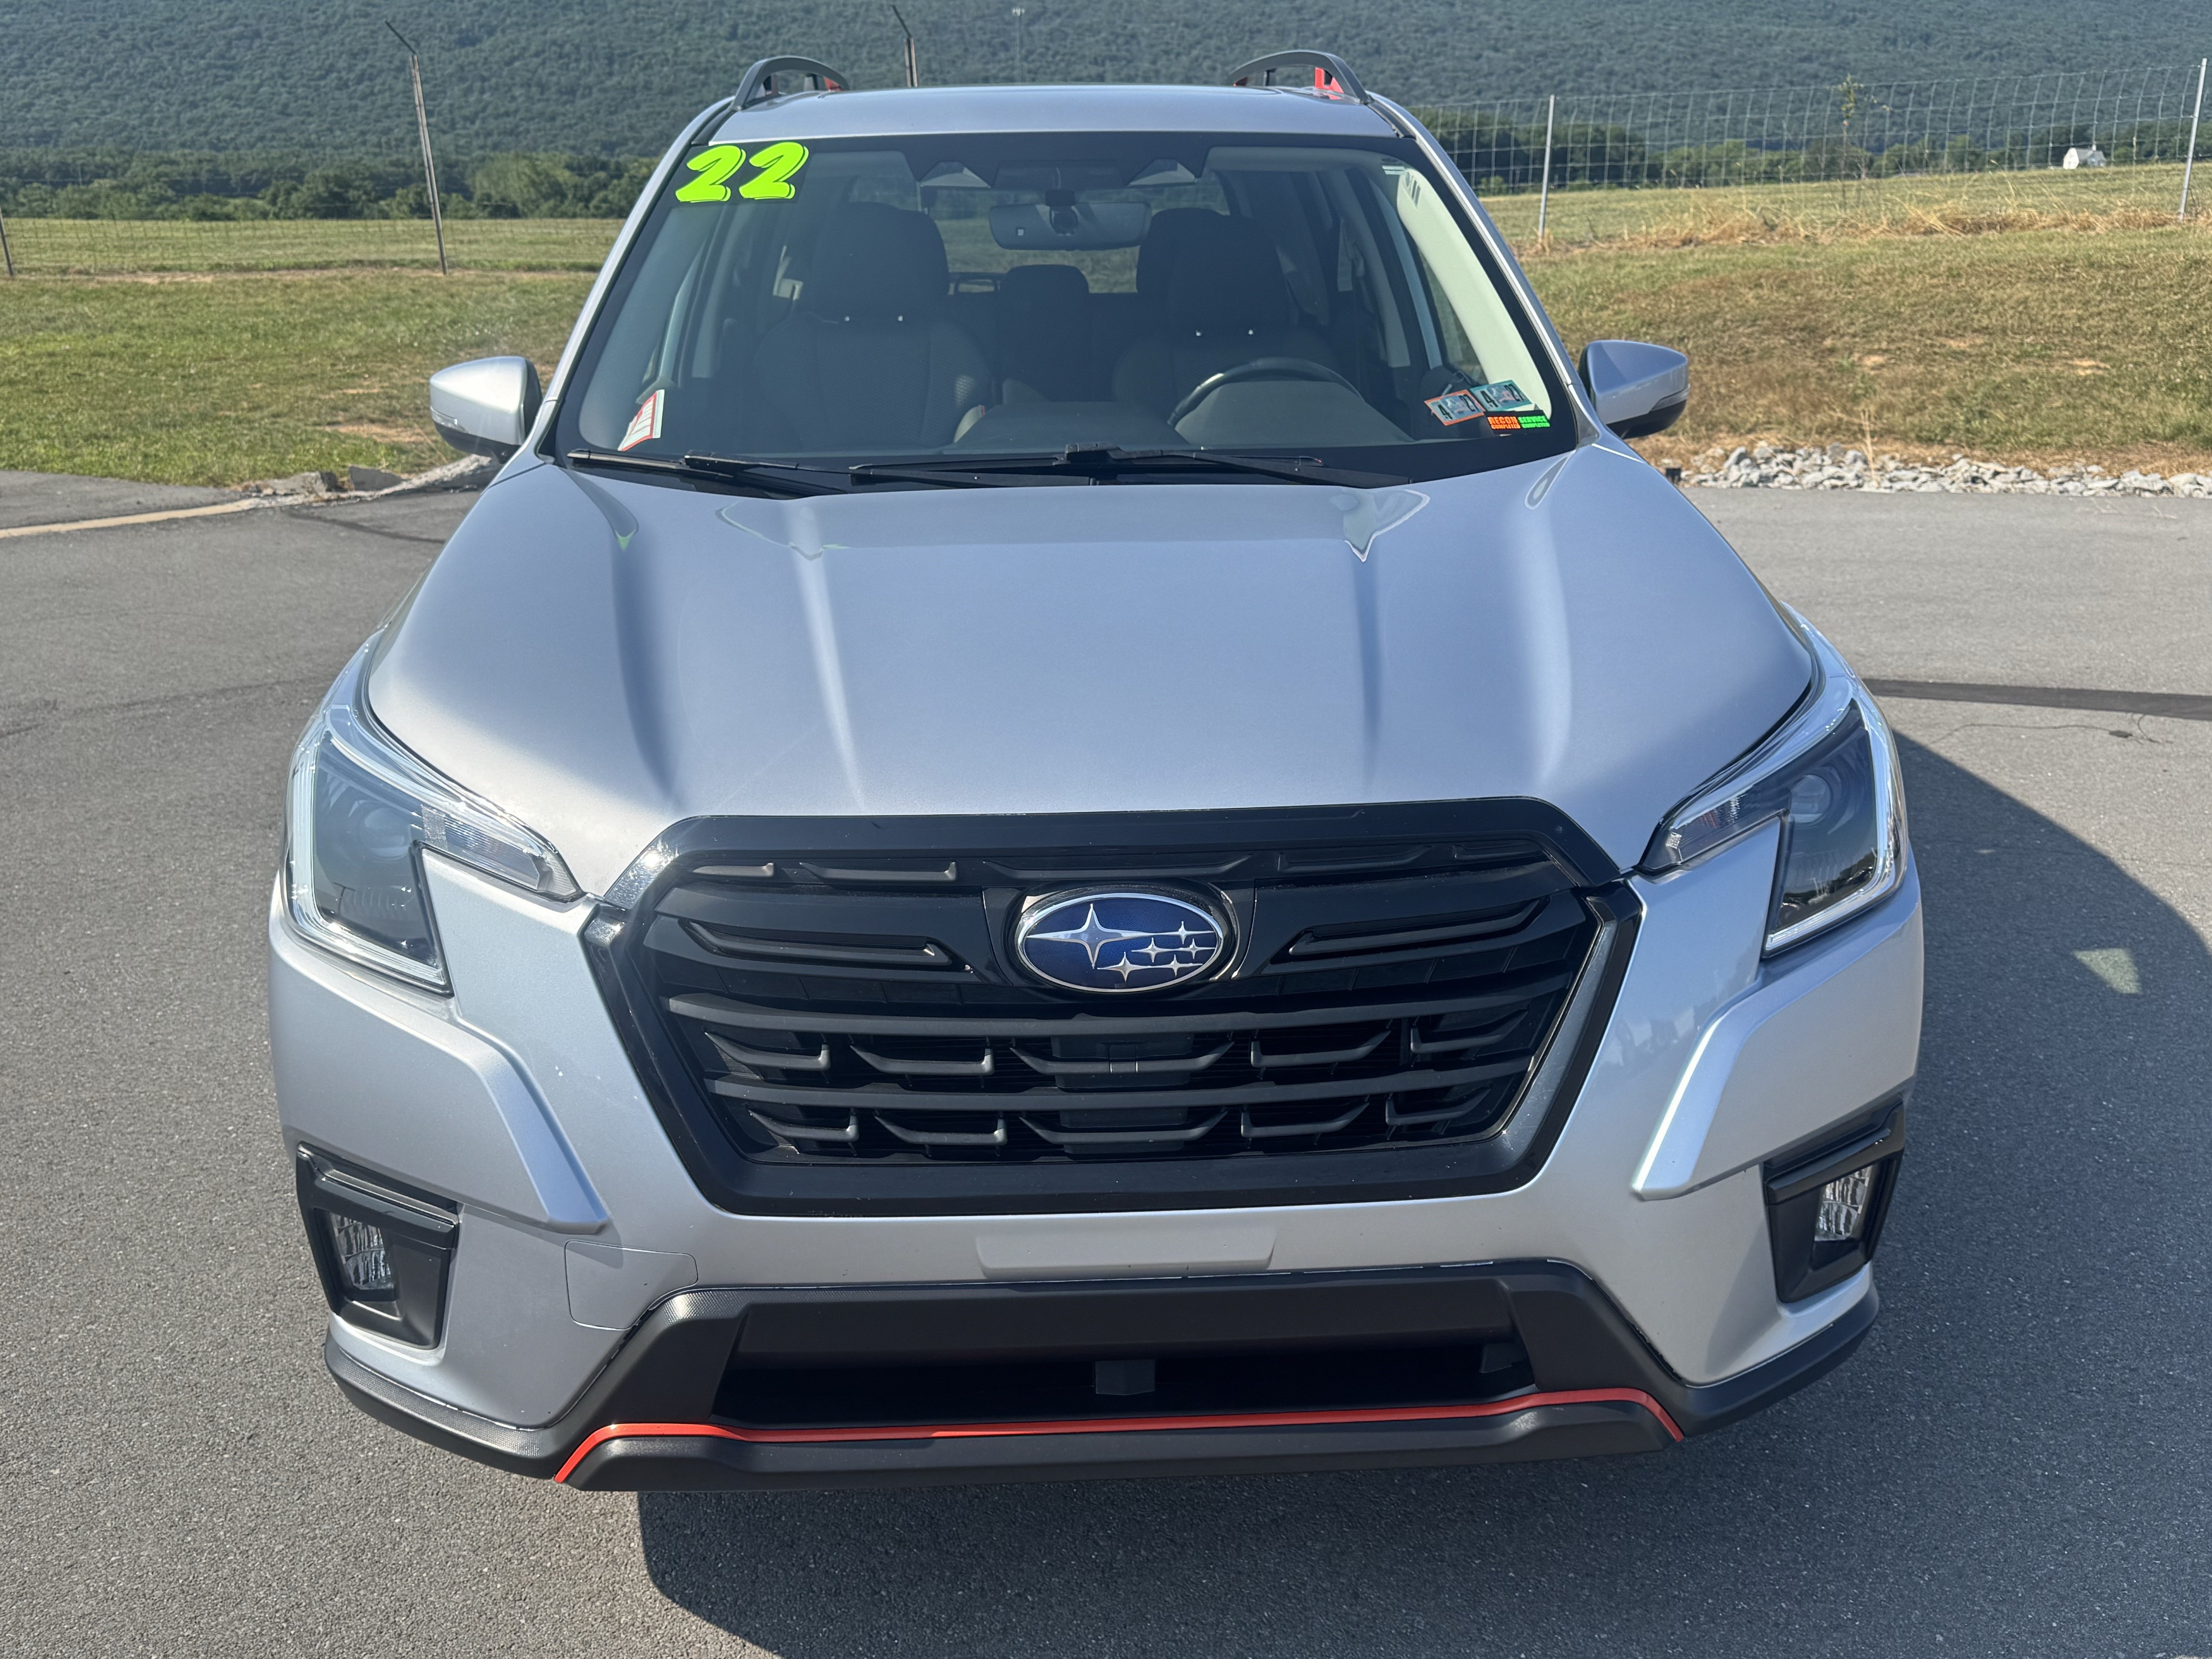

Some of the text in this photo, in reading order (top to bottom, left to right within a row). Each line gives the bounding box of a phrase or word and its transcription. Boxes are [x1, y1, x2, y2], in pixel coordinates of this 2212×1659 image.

[675, 142, 809, 203] 22
[1480, 390, 1498, 407] 4
[1438, 404, 1453, 419] 4
